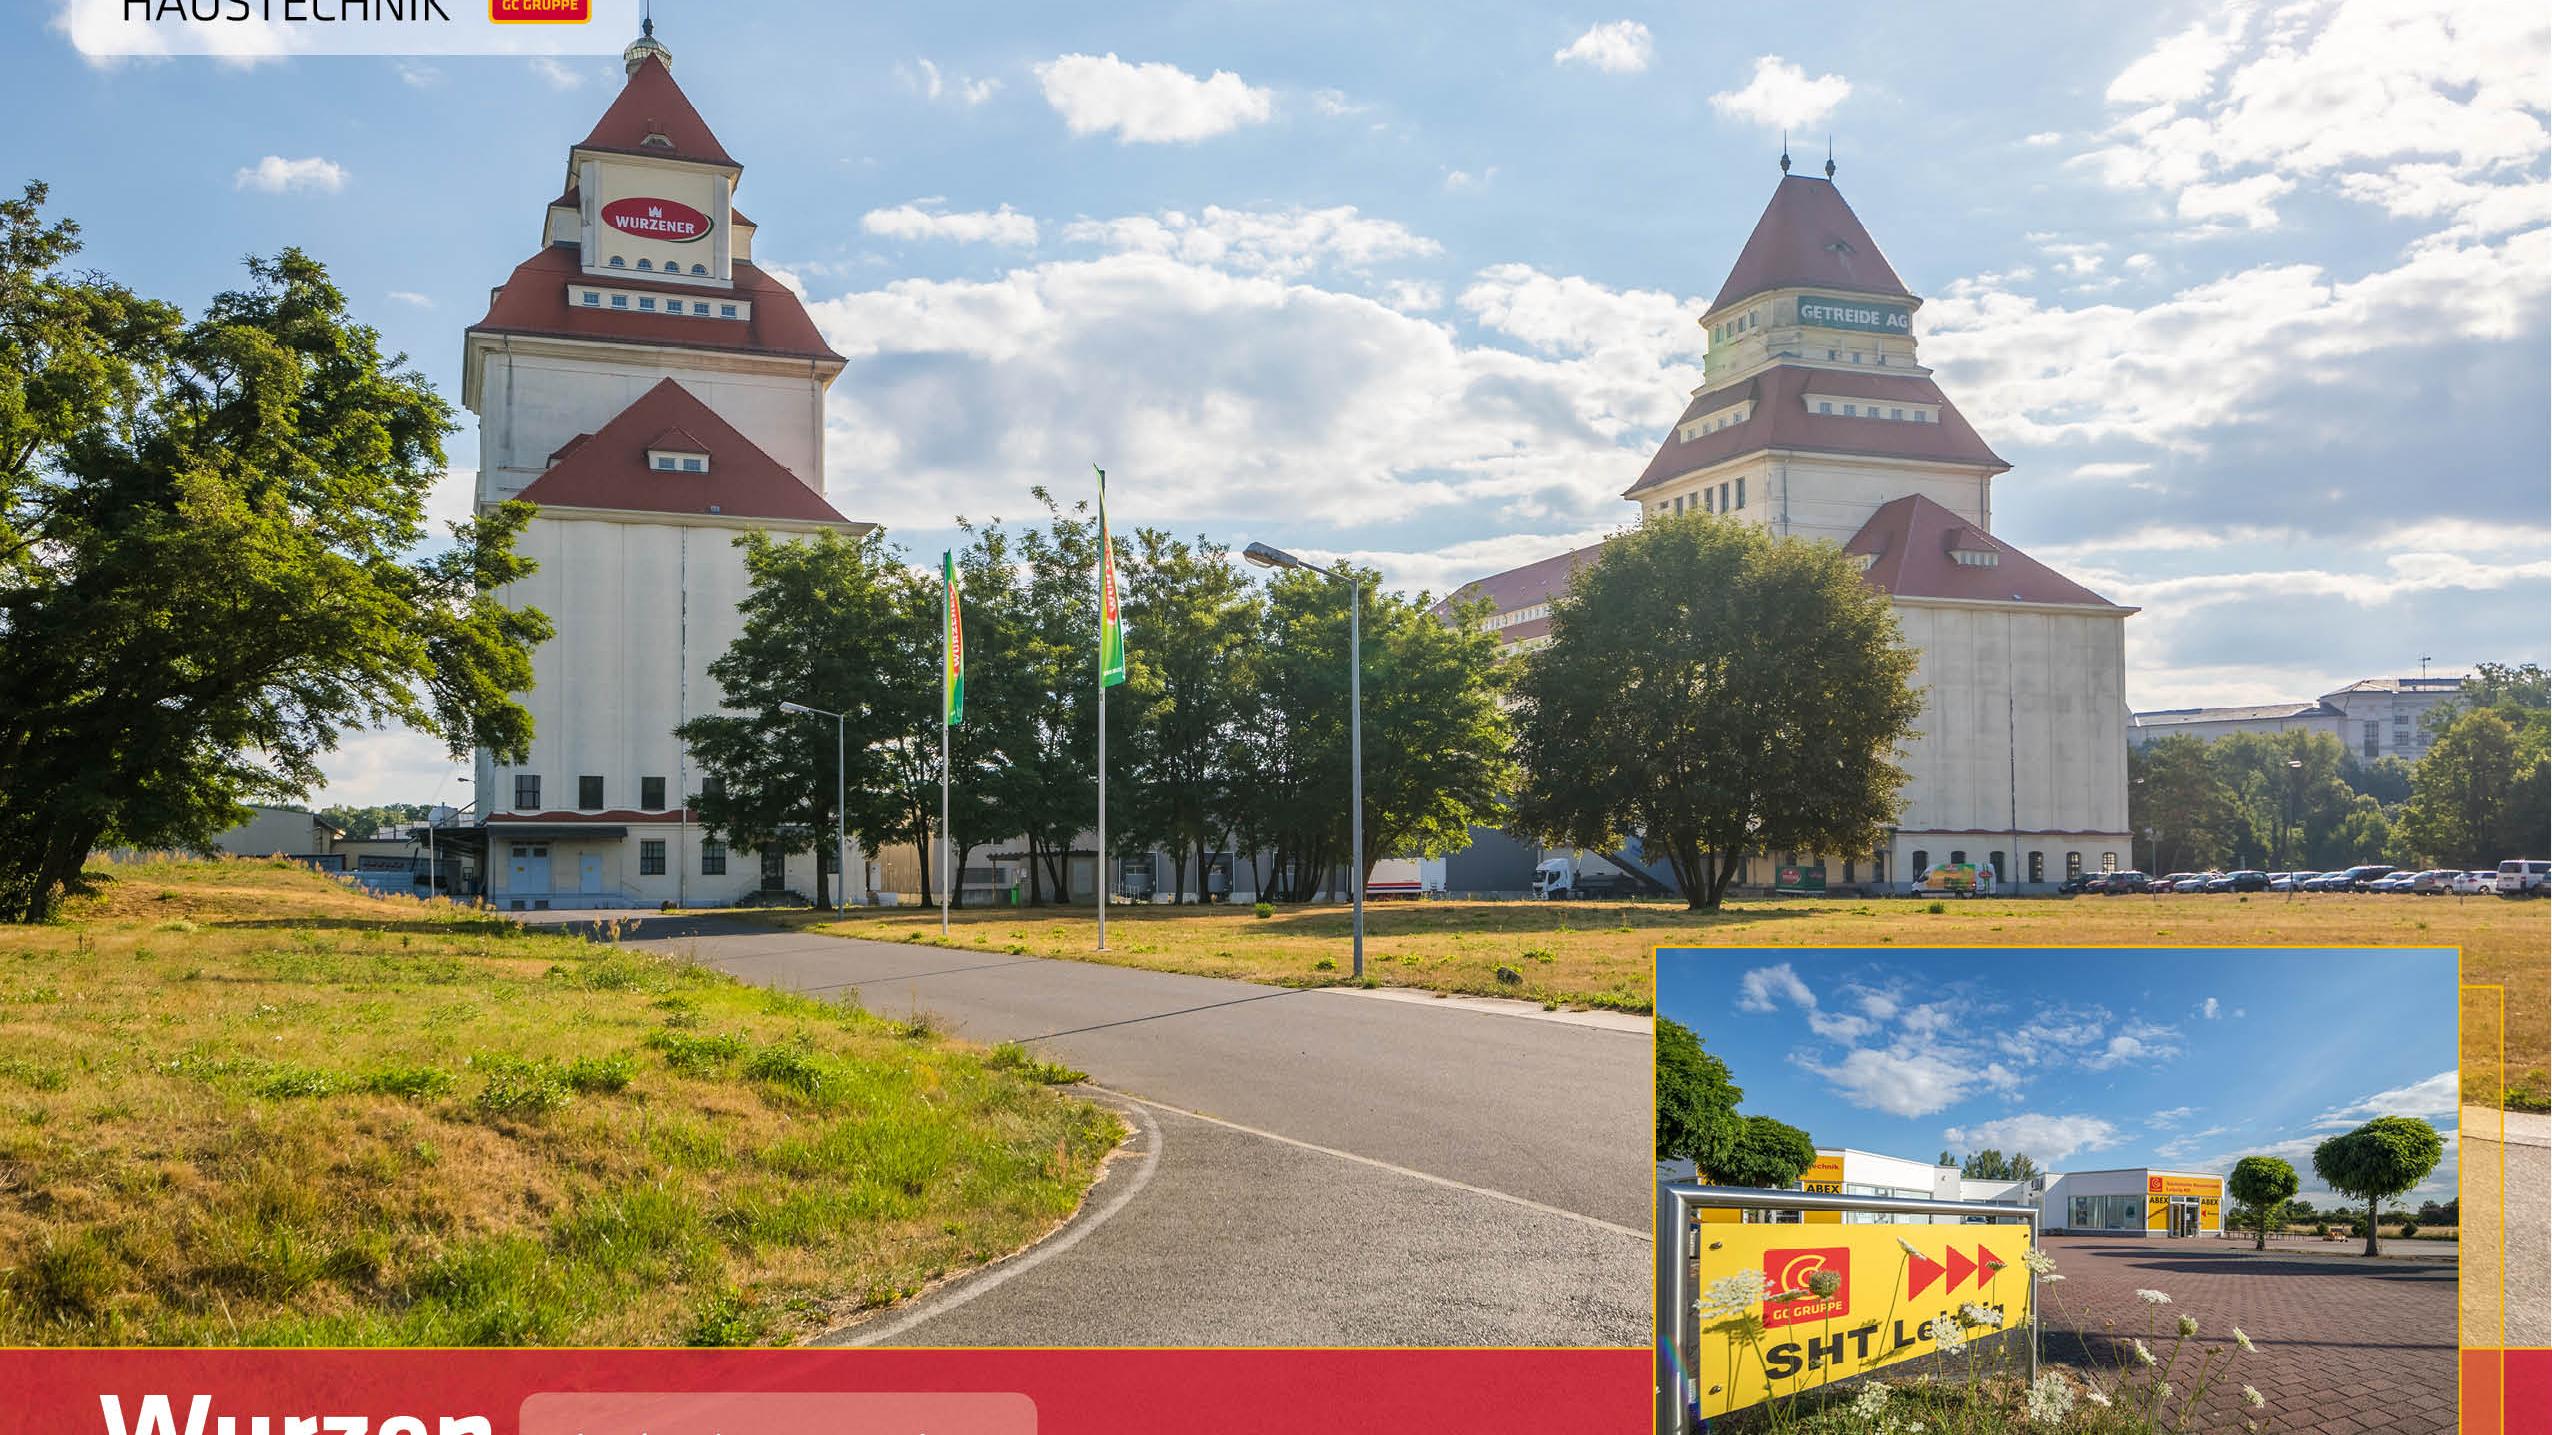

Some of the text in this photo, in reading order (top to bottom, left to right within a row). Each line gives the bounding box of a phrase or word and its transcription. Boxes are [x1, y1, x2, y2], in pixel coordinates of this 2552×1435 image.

[616, 215, 695, 234] WURZENER
[1801, 304, 1908, 328] GETREIDE AG
[1806, 1184, 1840, 1194] ABEX
[2149, 1196, 2169, 1204] ABEX
[2201, 1198, 2219, 1206] ABEX
[1793, 1301, 1843, 1317] GRUPPE
[1765, 1324, 1878, 1380] SHT
